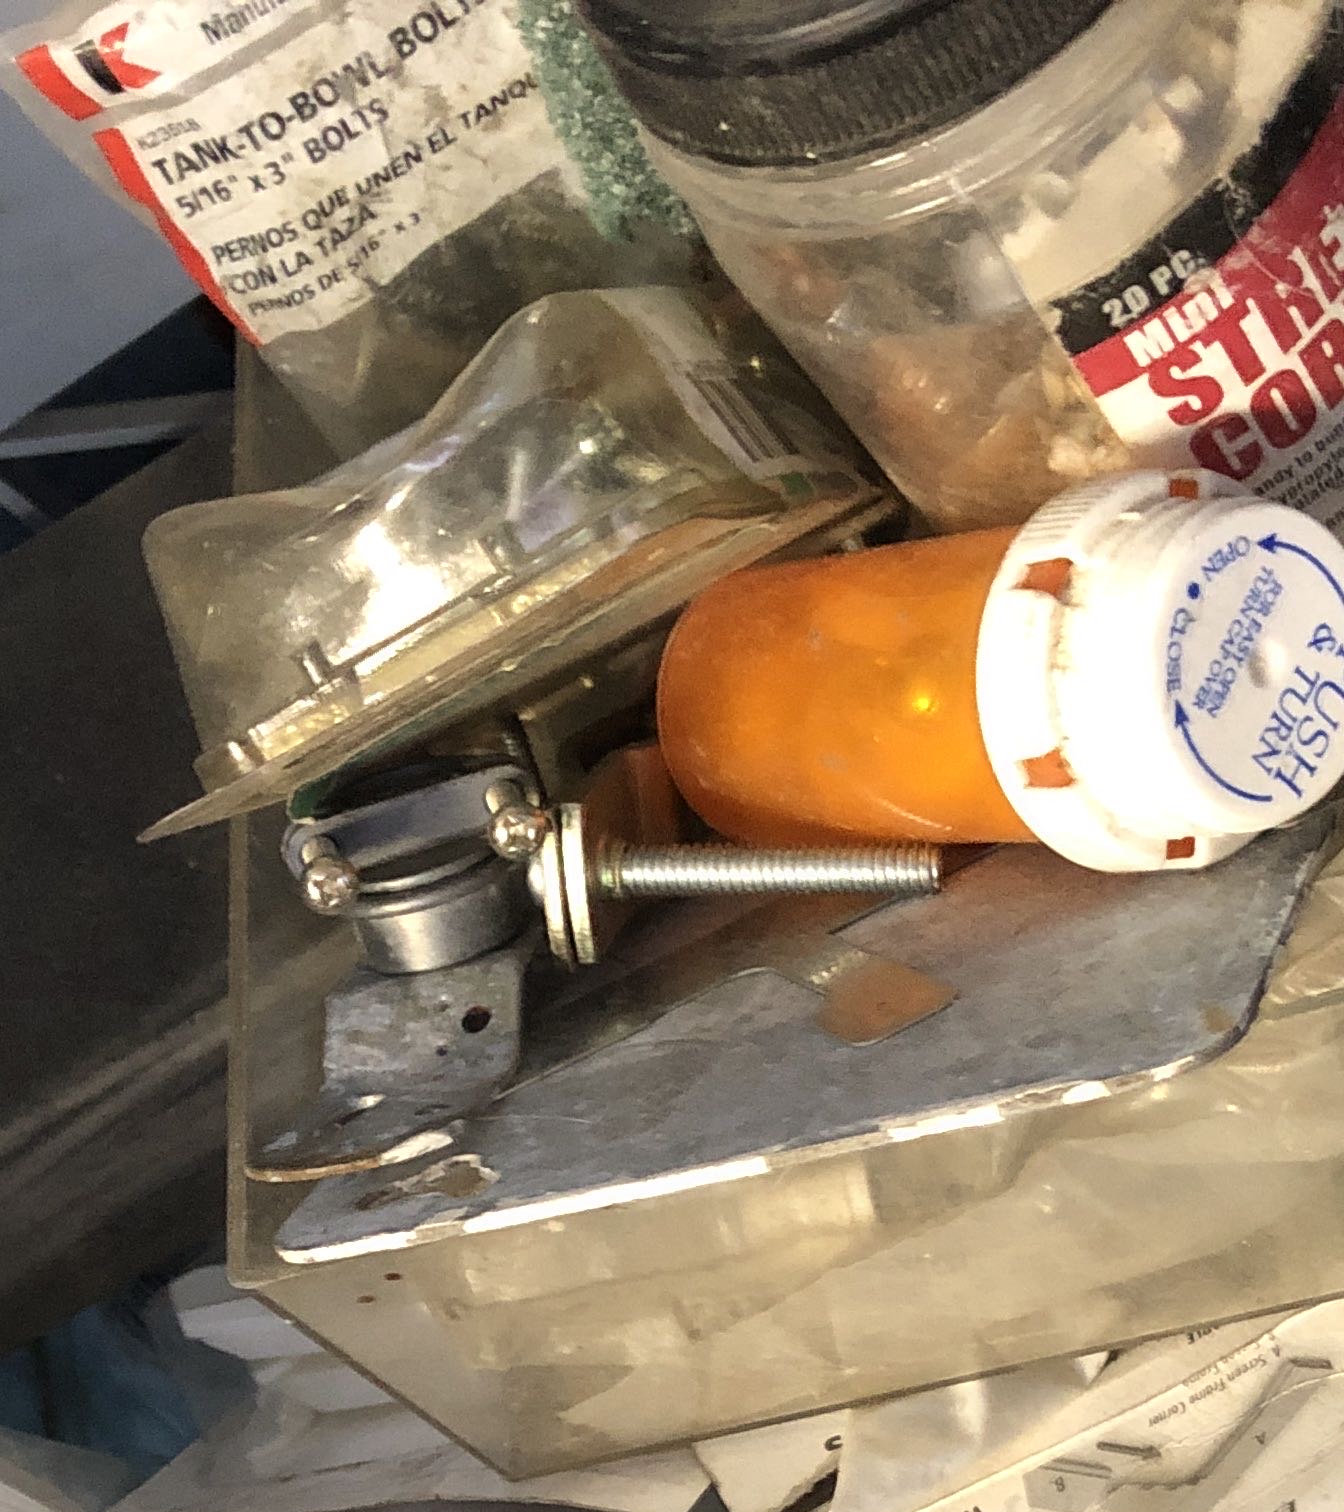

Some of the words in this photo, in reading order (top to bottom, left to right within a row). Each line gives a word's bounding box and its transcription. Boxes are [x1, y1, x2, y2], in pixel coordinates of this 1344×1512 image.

[175, 174, 238, 218] 5/16"
[247, 174, 267, 193] x
[264, 151, 295, 186] 3"
[302, 97, 390, 164] BOLTS
[211, 221, 299, 265] PERNOS
[301, 184, 351, 231] QUE
[355, 140, 424, 197] UNEN
[425, 125, 459, 155] EL
[228, 264, 278, 295] CON
[279, 250, 314, 278] LA
[314, 202, 378, 258] TAZA
[248, 282, 317, 316] PERNOS
[317, 268, 345, 292] DE
[1102, 284, 1147, 328] 20
[1252, 464, 1294, 497] andy
[1201, 535, 1251, 583] OPEN
[1240, 566, 1275, 619] TURN
[1260, 578, 1284, 617] FOR
[1166, 607, 1196, 694] CLOSE
[1220, 618, 1244, 660] CAP
[1232, 616, 1263, 667] EASY
[1307, 622, 1337, 653] &
[1192, 659, 1223, 710] OVER
[1206, 667, 1237, 718] OPEN
[1252, 666, 1320, 775] TURN
[1188, 1378, 1226, 1404] Frame
[1226, 1353, 1268, 1382] Screen
[1147, 1401, 1186, 1429] Corner
